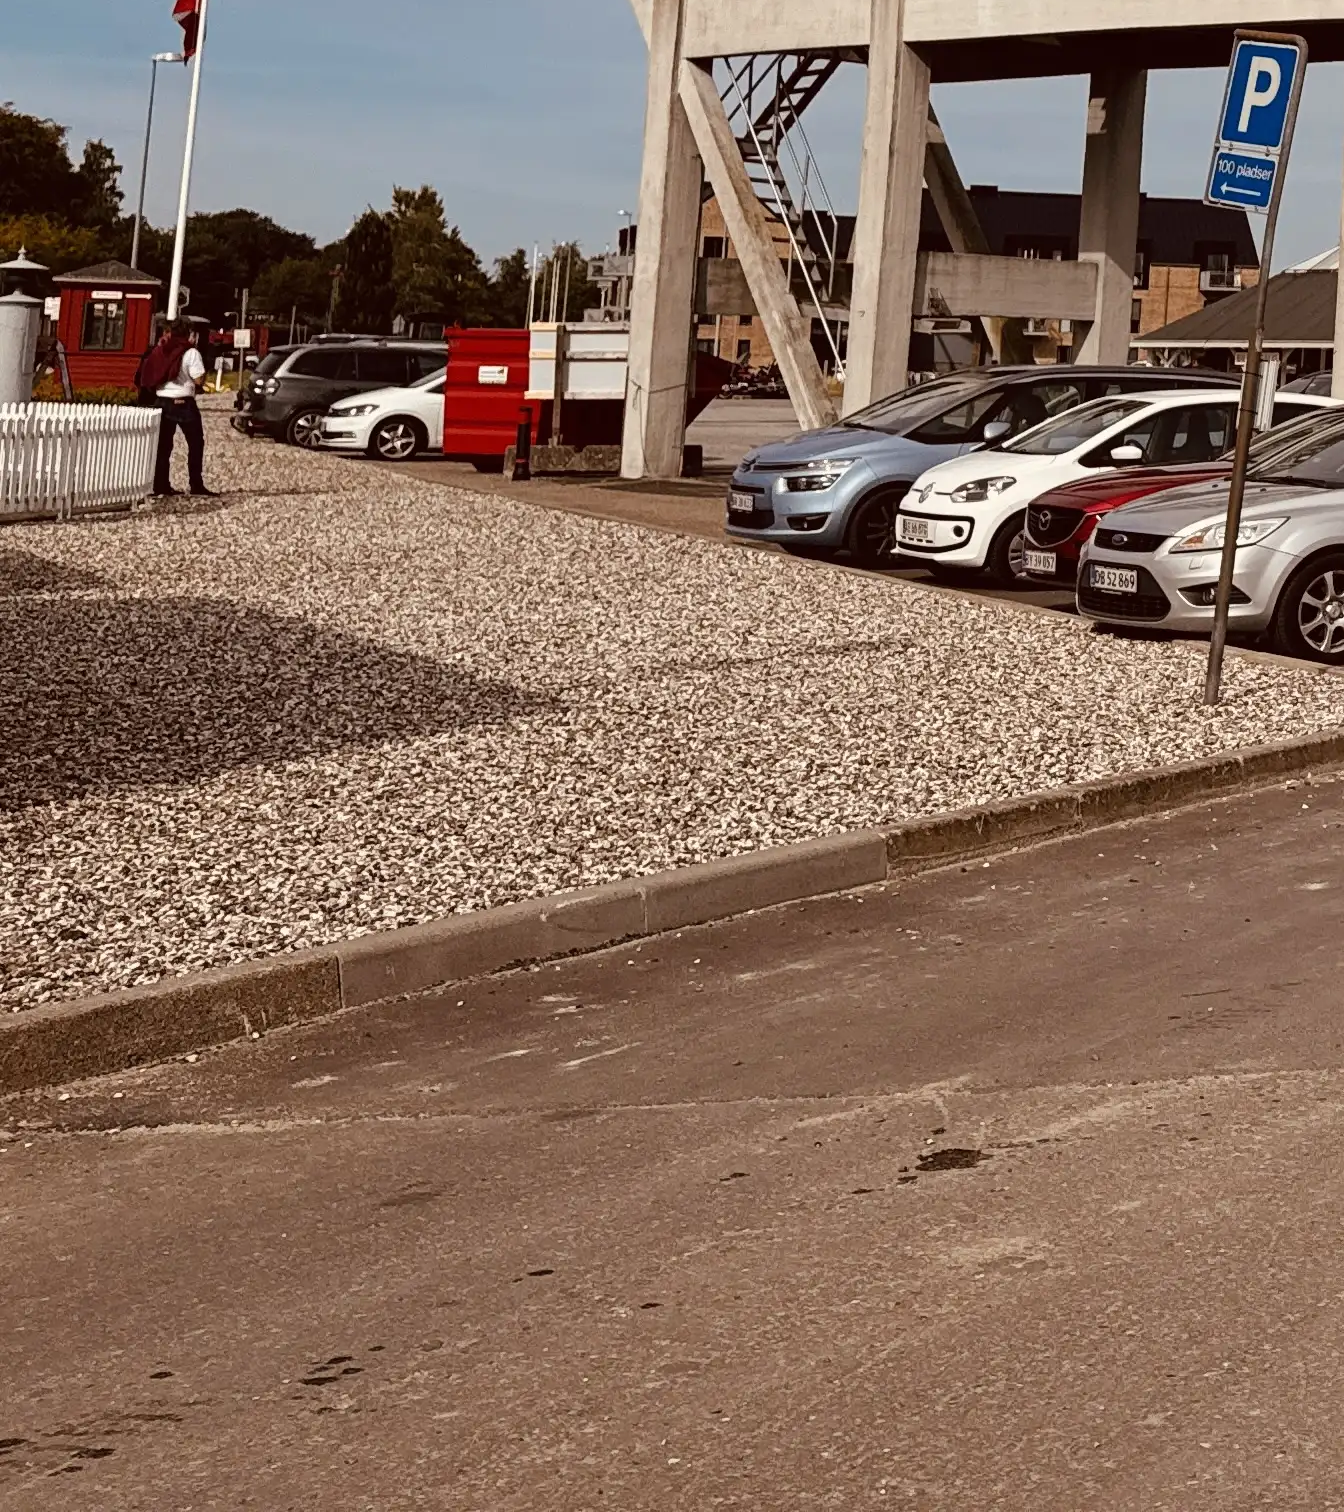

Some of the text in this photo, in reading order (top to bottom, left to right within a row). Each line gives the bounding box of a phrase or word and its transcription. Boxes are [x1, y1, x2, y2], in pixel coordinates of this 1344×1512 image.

[1238, 56, 1281, 132] P
[1218, 158, 1274, 181] 100 pladser
[1042, 555, 1055, 570] 057
[1095, 569, 1135, 589] DB 52 869
